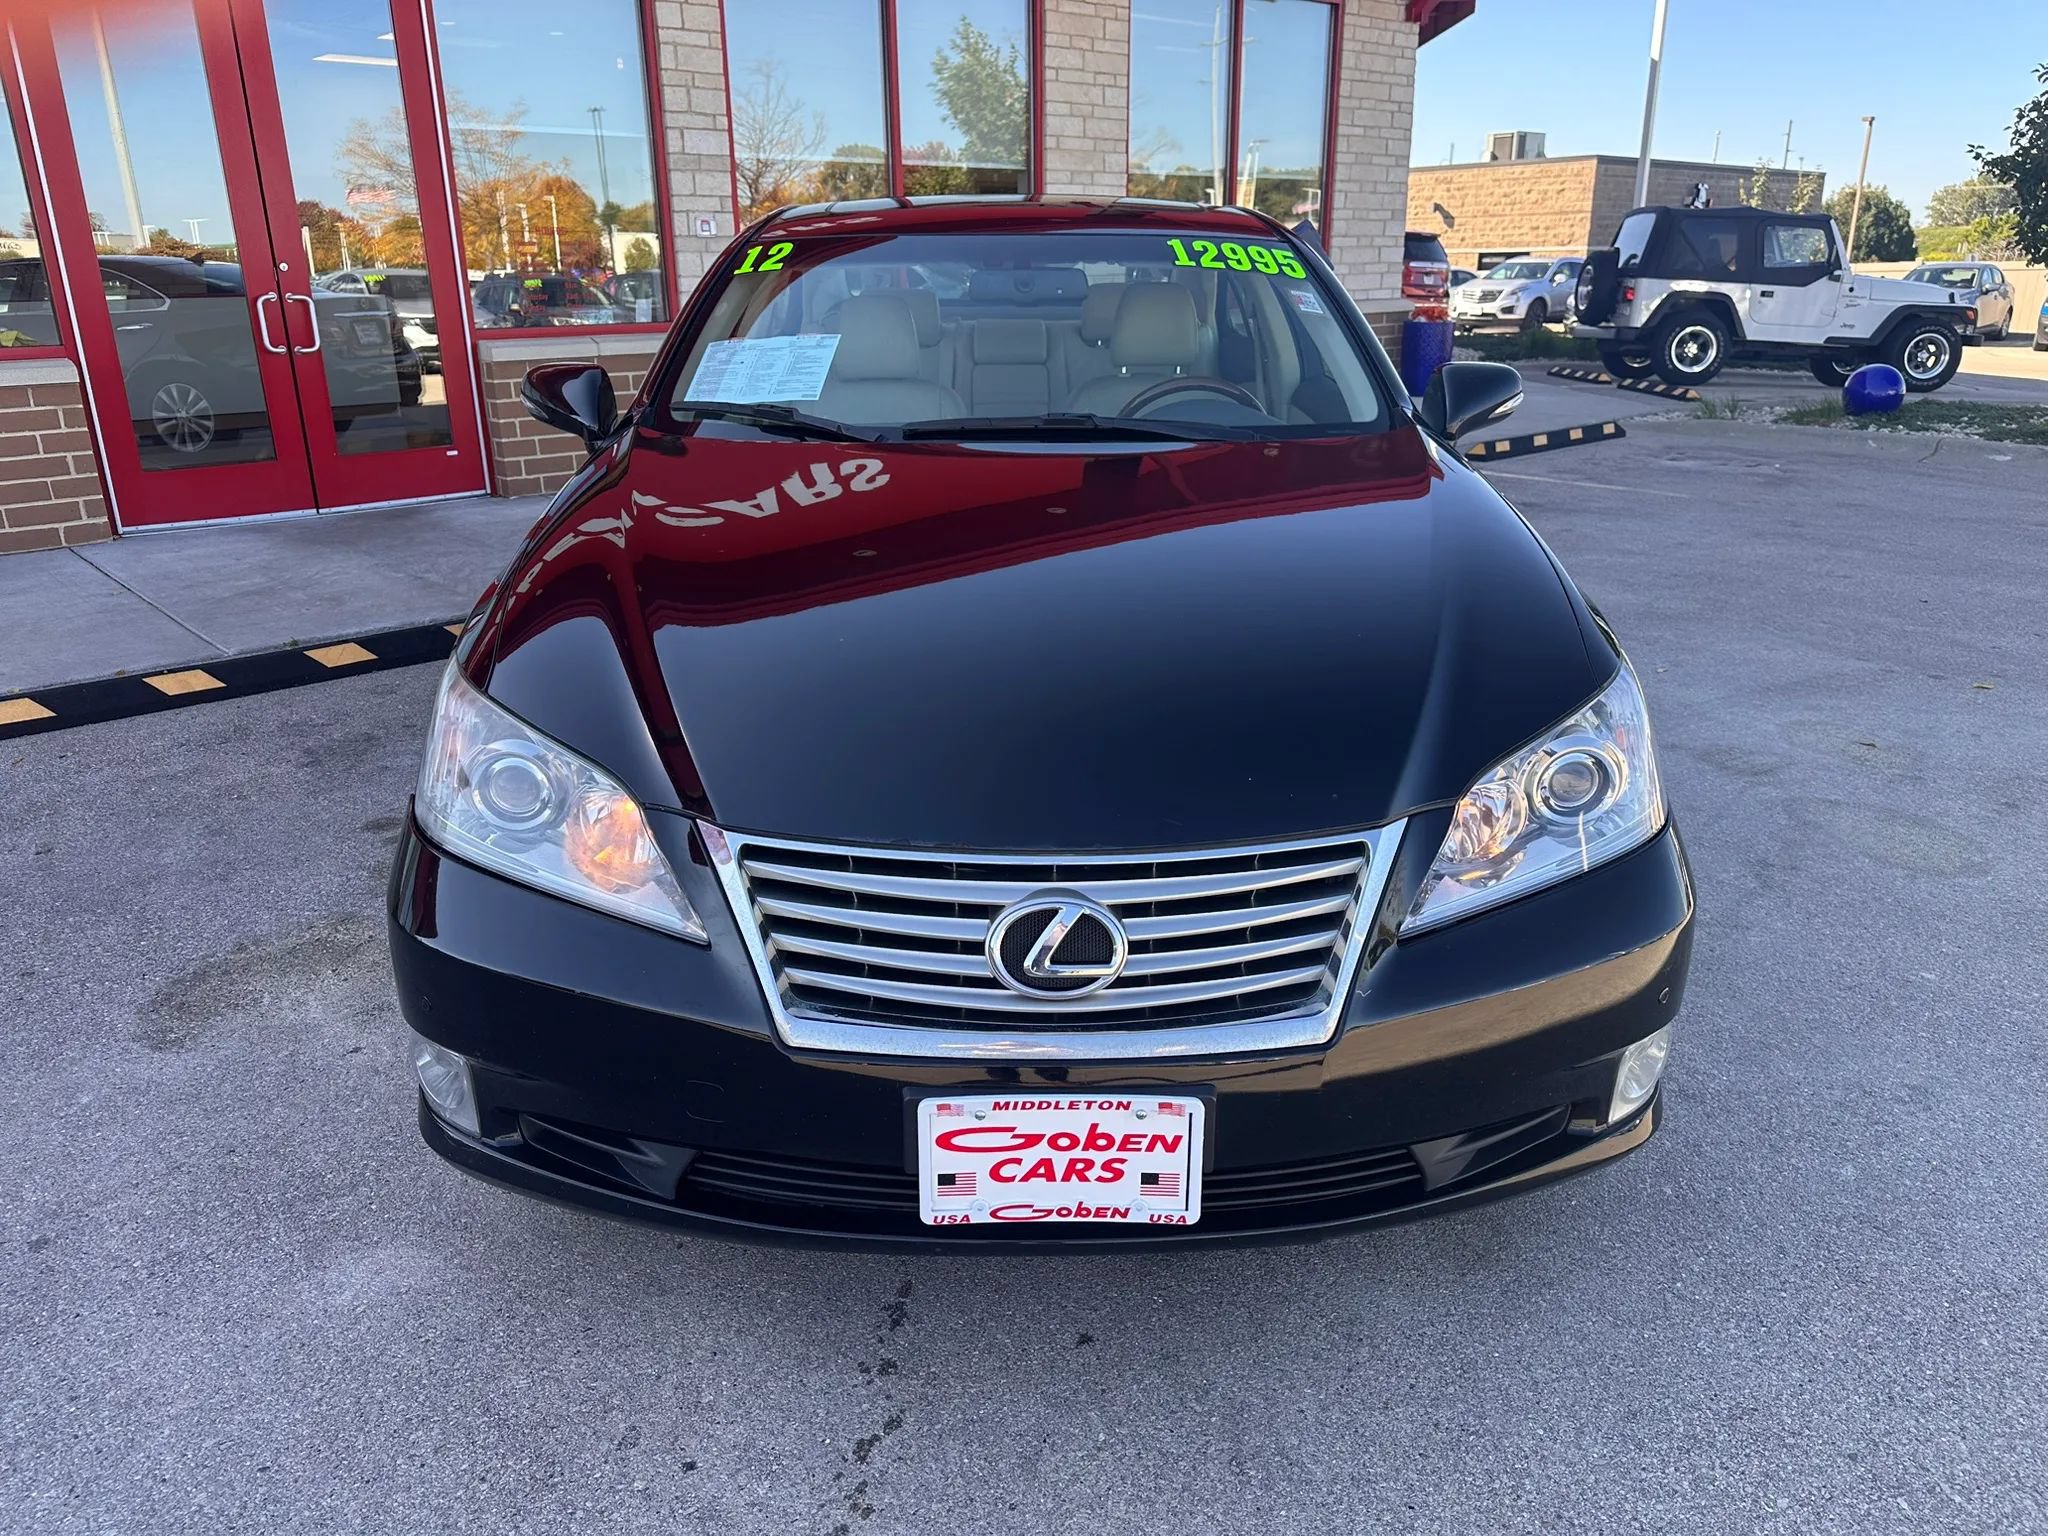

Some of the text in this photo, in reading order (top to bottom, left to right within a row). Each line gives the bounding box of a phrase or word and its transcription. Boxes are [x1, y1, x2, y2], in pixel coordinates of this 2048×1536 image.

[733, 241, 794, 275] 12
[1166, 238, 1307, 280] 12995
[991, 1100, 1133, 1113] MIDDLETON
[988, 1157, 1129, 1184] CARS
[932, 1214, 972, 1225] USA
[1149, 1214, 1188, 1225] USA
